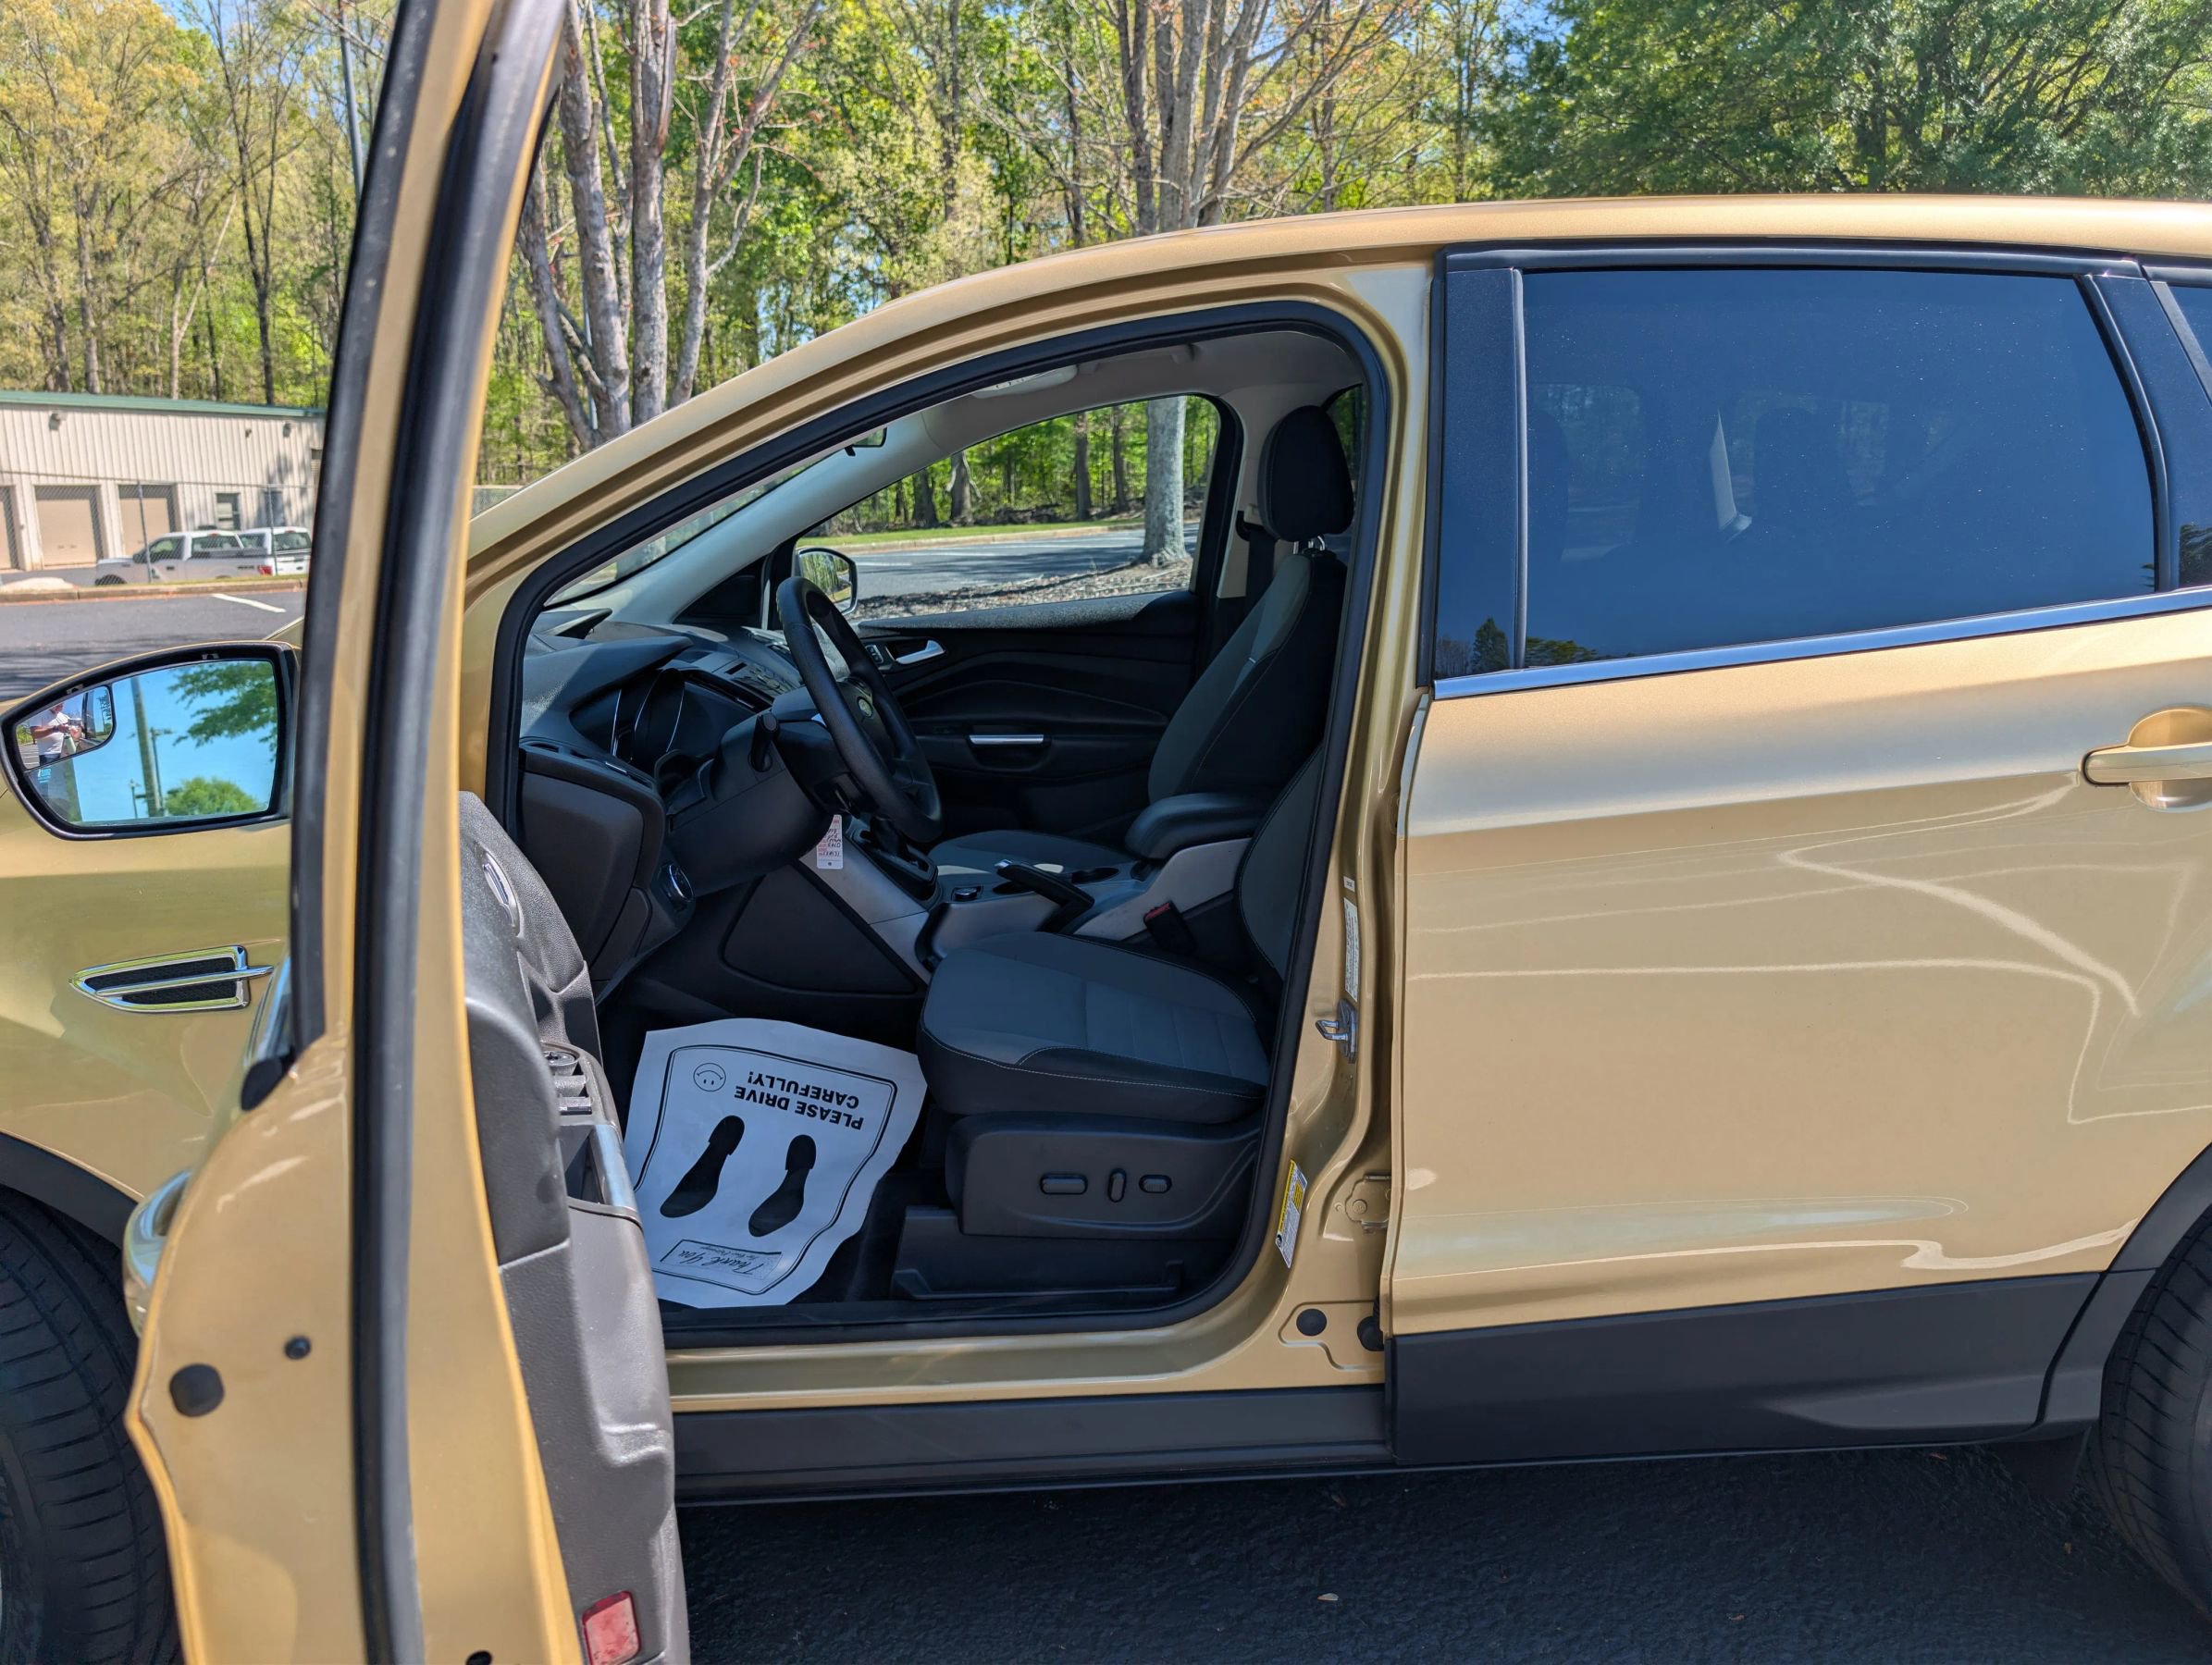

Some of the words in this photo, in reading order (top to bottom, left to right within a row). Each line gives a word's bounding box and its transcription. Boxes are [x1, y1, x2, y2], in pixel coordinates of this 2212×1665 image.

[735, 1086, 790, 1110] DRIVE
[748, 1071, 859, 1109] CAREFULLY!
[795, 1101, 864, 1130] PLEASE
[678, 1251, 705, 1264] You
[701, 1256, 764, 1275] Thank
